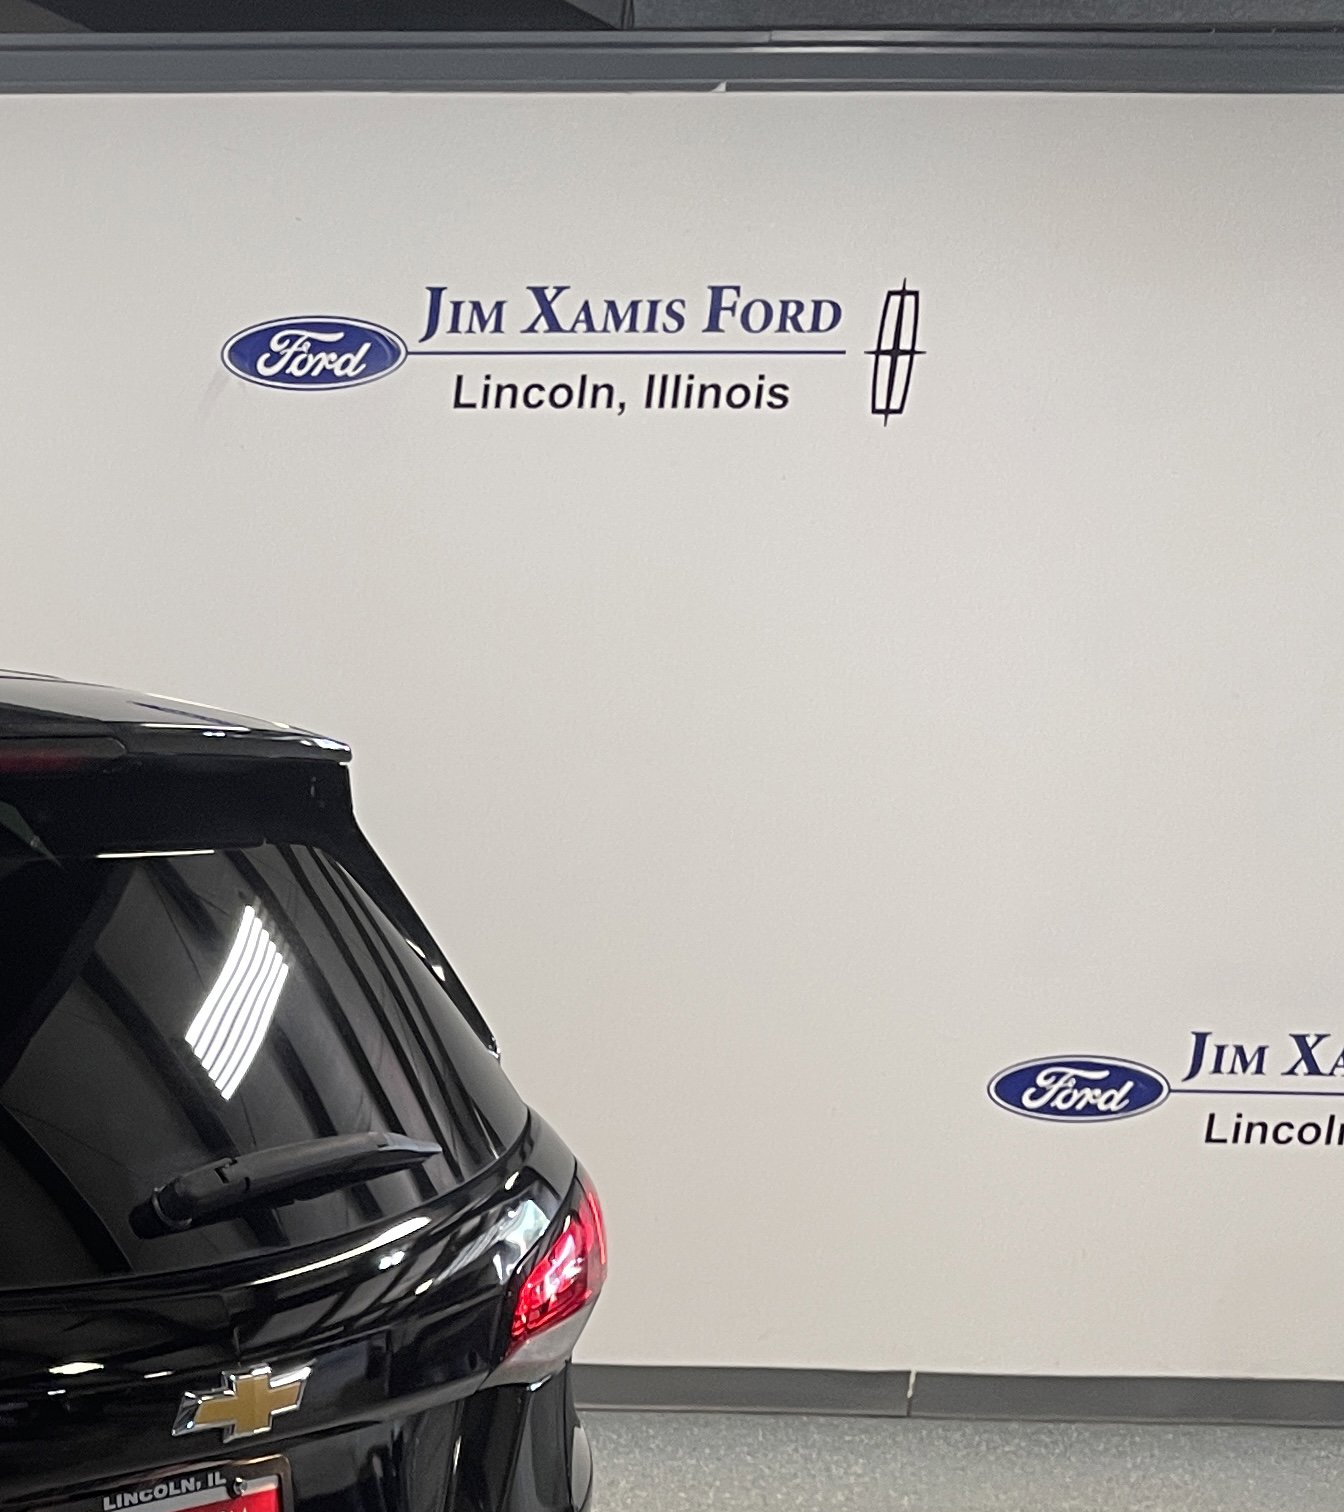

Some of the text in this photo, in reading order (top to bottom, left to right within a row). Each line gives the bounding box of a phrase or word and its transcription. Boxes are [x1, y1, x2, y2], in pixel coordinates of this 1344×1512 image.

[419, 285, 844, 343] JIM XAMIS FORD
[255, 329, 370, 378] Ford
[452, 373, 791, 416] Lincoln, Illinois
[1182, 1031, 1270, 1082] JIM
[1020, 1065, 1135, 1112] Ford
[102, 1471, 227, 1511] LINCOLN, IL
